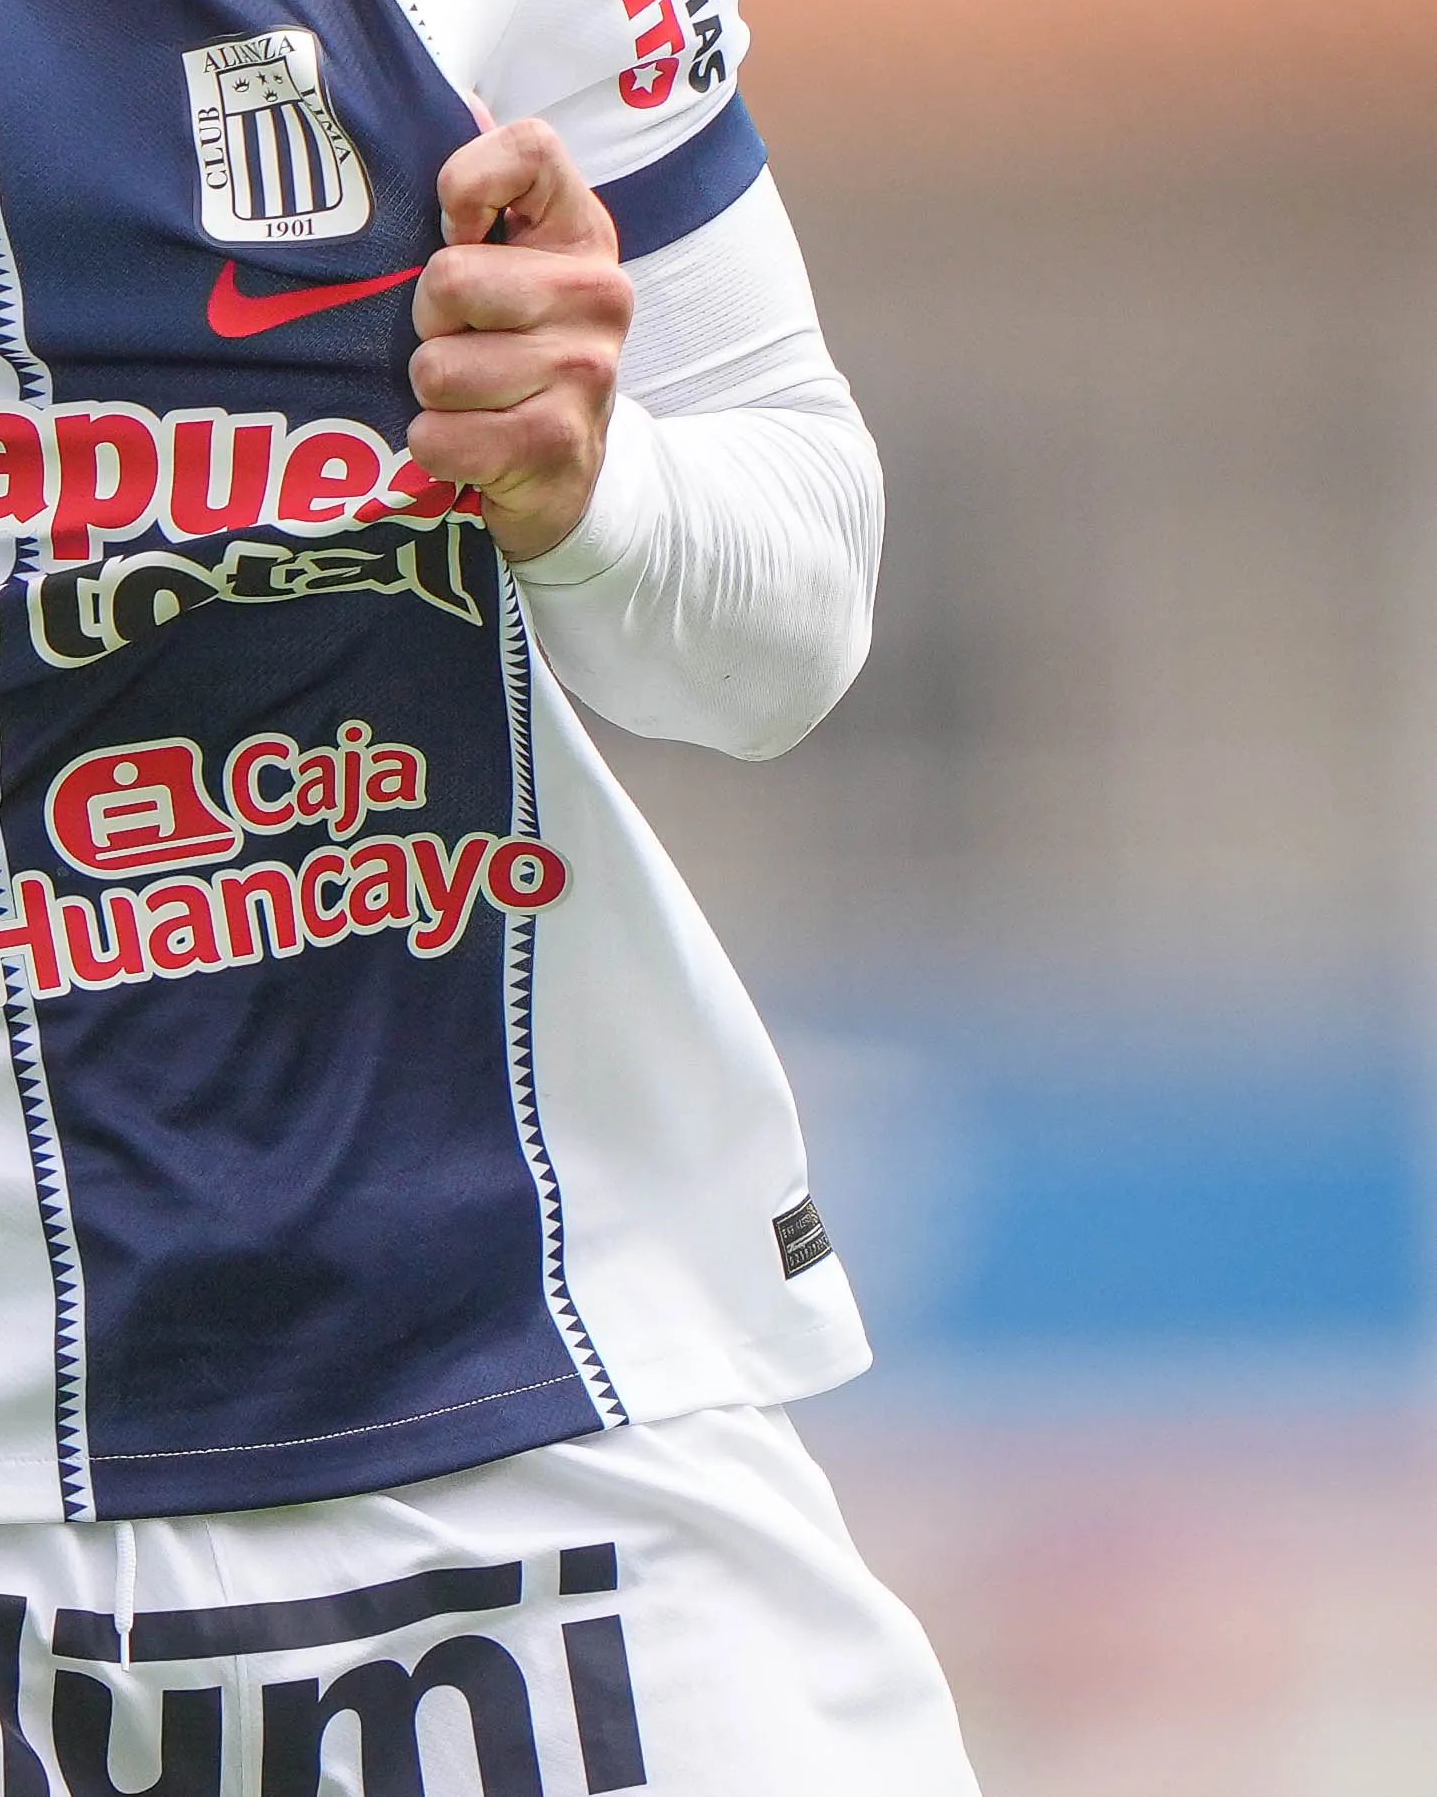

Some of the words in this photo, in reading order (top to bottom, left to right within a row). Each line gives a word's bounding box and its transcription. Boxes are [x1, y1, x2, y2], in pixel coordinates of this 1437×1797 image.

[202, 35, 296, 74] ALIANZA
[198, 106, 229, 190] CLUB
[300, 84, 352, 164] LIMA
[265, 218, 315, 238] 1901
[230, 725, 419, 833] Caja
